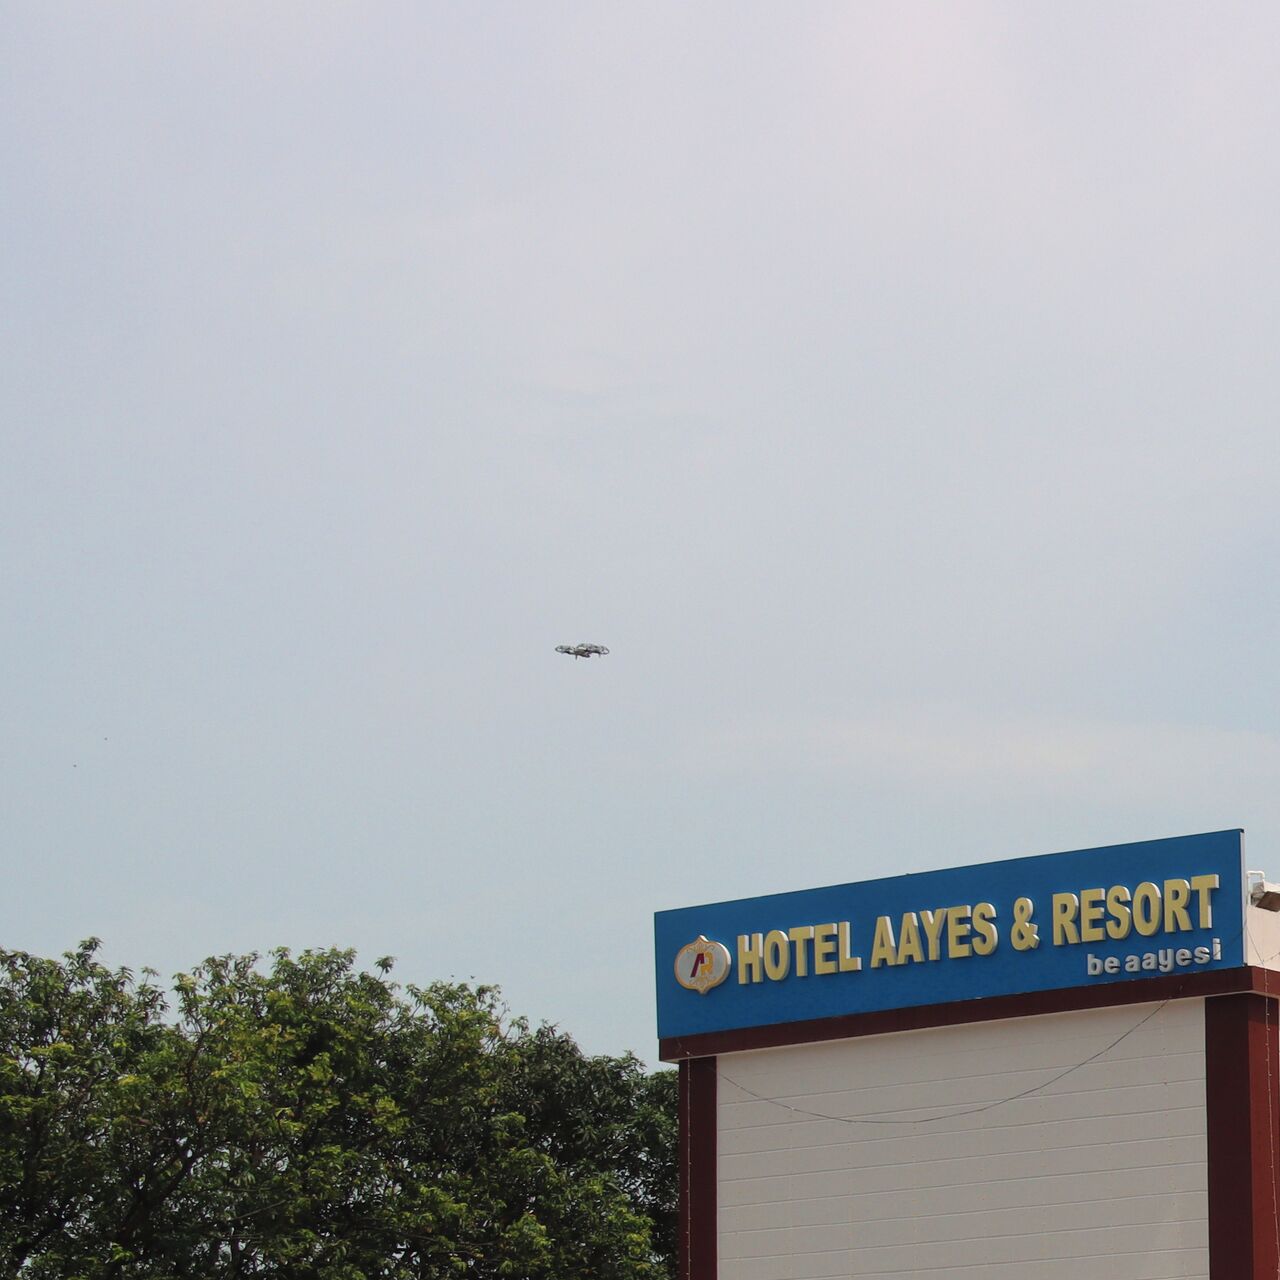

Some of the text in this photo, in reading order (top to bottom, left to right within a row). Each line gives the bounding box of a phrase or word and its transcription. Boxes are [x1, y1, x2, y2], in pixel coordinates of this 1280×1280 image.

[737, 874, 1219, 985] HOTEL AAYES & RESORT
[1087, 953, 1120, 976] be
